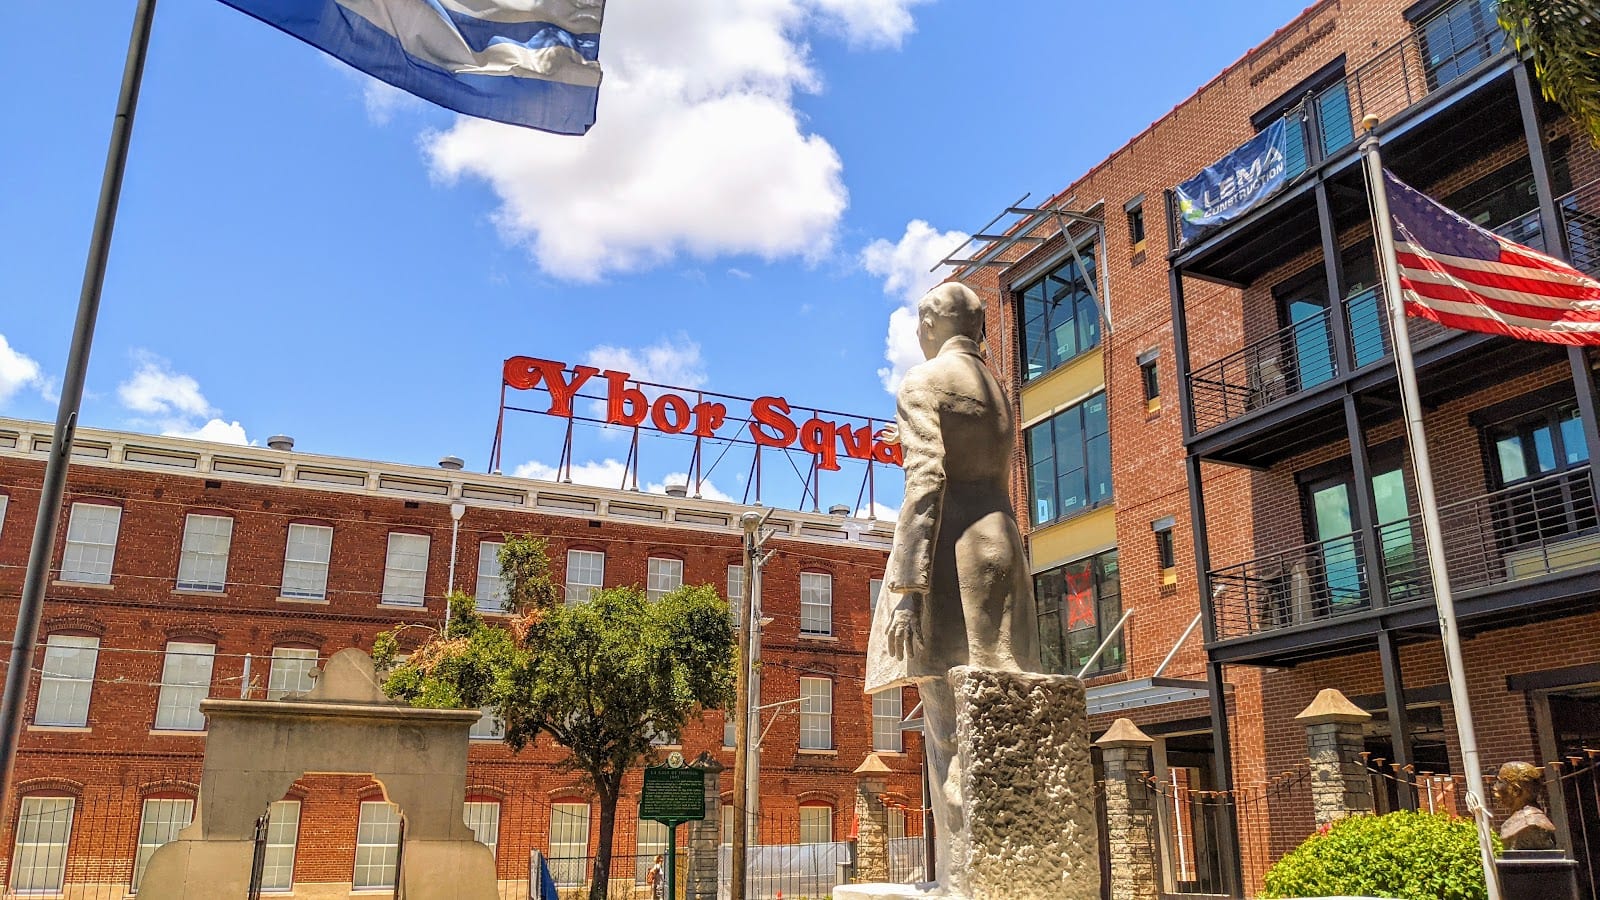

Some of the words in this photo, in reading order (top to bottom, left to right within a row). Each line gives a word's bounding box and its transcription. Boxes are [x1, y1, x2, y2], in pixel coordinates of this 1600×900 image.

[1204, 147, 1283, 208] LEMA
[1204, 162, 1284, 218] CONSTRUCTION
[503, 355, 727, 438] Ybor
